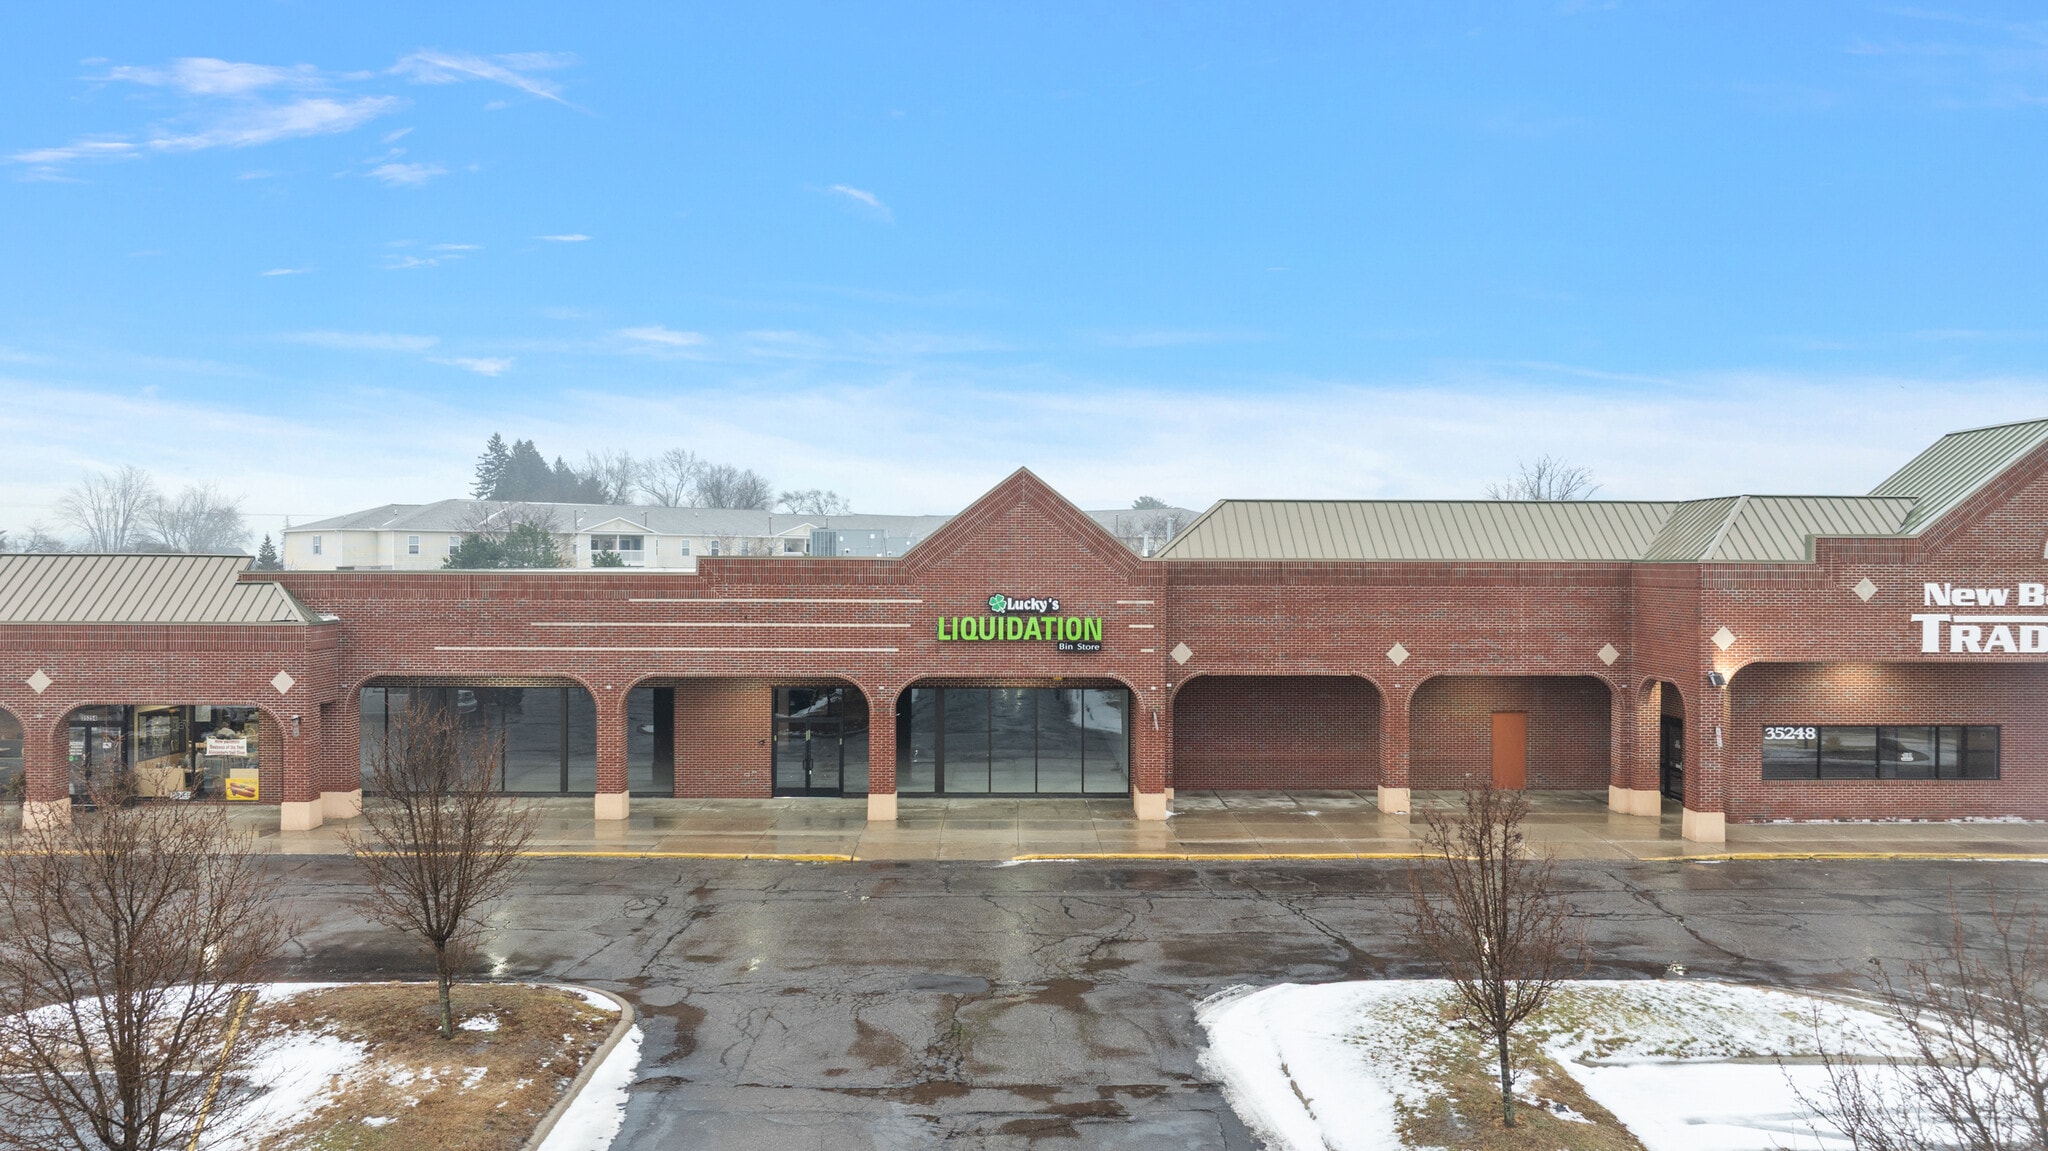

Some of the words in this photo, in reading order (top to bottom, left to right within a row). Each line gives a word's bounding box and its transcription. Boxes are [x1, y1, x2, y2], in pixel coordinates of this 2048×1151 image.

[1924, 583, 2009, 606] New
[1007, 598, 1060, 612] Lucky's
[938, 616, 1102, 641] LIQUIDATION
[1911, 613, 2048, 653] TRAD
[1058, 642, 1074, 651] Bin
[1076, 642, 1100, 651] Store
[1764, 726, 1816, 740] 35248
